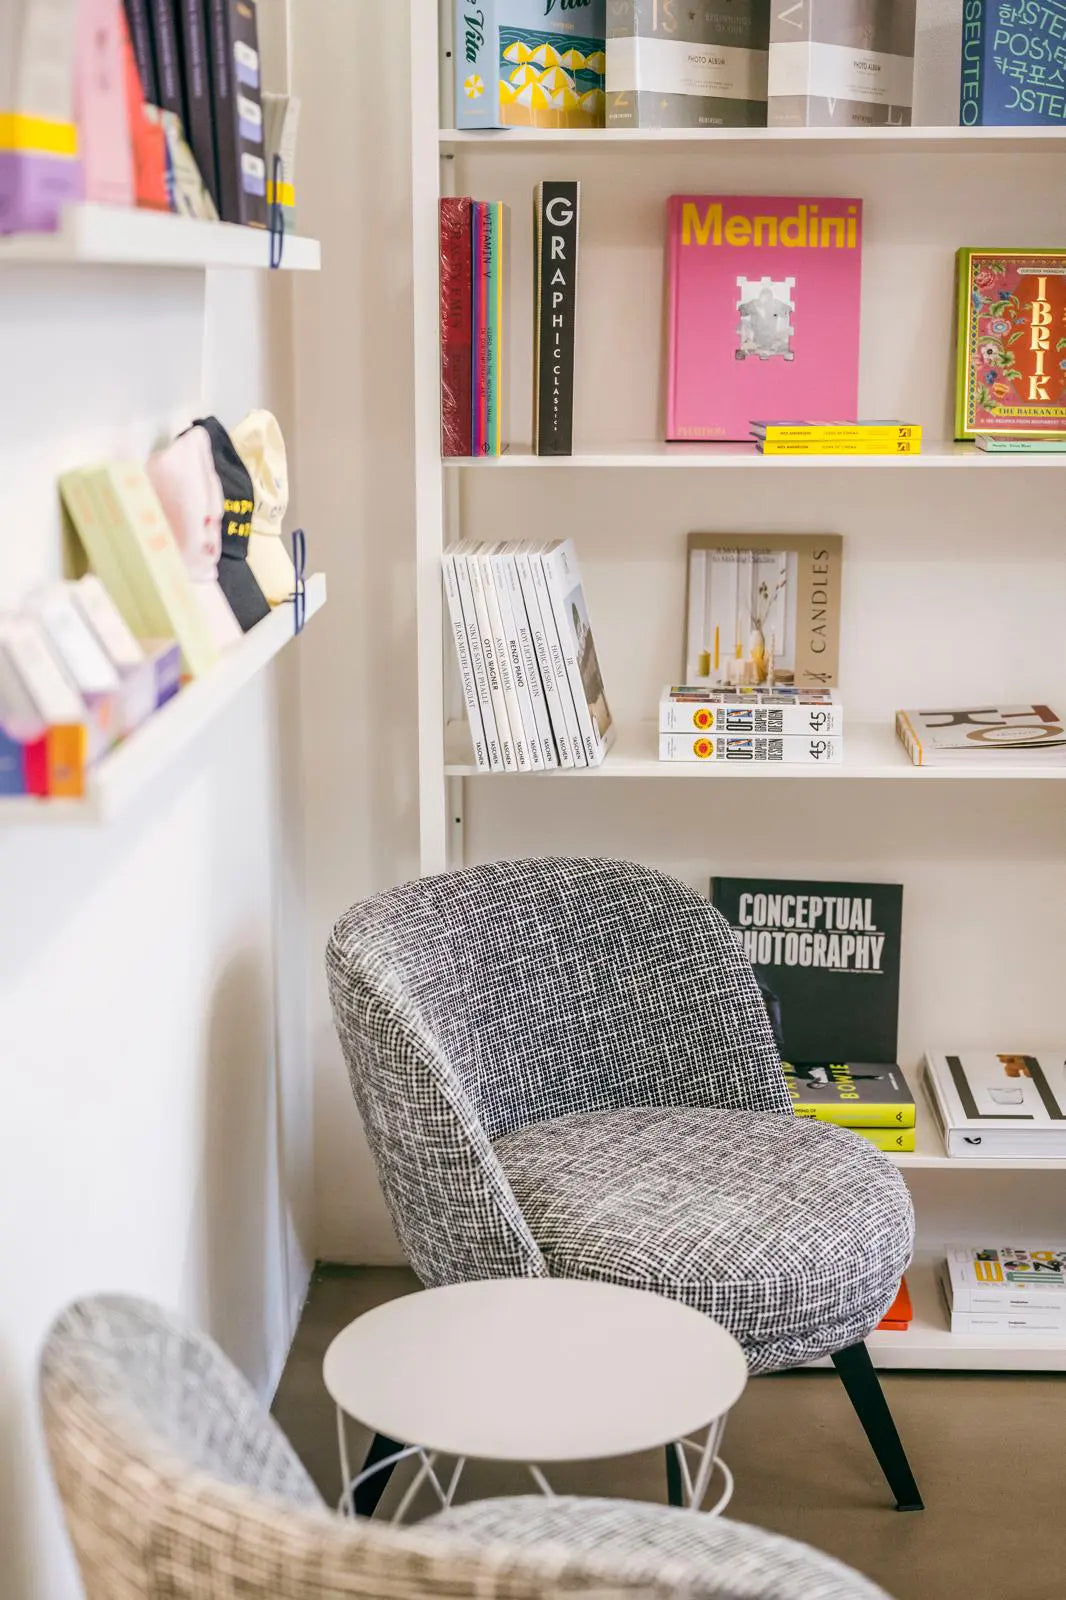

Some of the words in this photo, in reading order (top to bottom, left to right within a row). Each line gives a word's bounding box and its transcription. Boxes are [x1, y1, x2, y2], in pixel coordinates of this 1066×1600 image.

[464, 10, 485, 64] Vita
[688, 56, 706, 64] PHOTO
[708, 56, 726, 65] ALBUM
[854, 60, 868, 70] PHOTO
[681, 202, 857, 248] Mendini
[482, 212, 492, 264] VITAMIN
[482, 270, 492, 279] V
[544, 197, 574, 358] GRAPHIC
[1028, 277, 1053, 401] IBRIK
[811, 549, 828, 654] CANDLES
[468, 623, 476, 640] NIKI
[519, 628, 528, 643] ROY
[471, 641, 478, 650] DE
[483, 638, 492, 658] OTTO
[473, 651, 483, 674] SAINT
[523, 644, 539, 697] LICHTENSTEIN
[487, 660, 498, 690] WAGNER
[453, 621, 468, 671] JEAN-MICHEL
[463, 672, 475, 708] BASQUIAT
[475, 741, 484, 765] TASCHEN
[478, 676, 488, 705] PHALLE
[495, 636, 504, 658] ANDY
[500, 659, 512, 692] WARHOL
[516, 741, 525, 764] TASCHEN
[509, 640, 519, 663] RENZO
[514, 665, 524, 687] PIANO
[530, 739, 538, 762] TASCHEN
[534, 630, 547, 664] GRAPHIC
[542, 665, 553, 692] DESIGN
[559, 736, 567, 760] TASCHEN
[550, 644, 563, 678] HOKUSAI
[572, 736, 580, 759] TASCHEN
[726, 718, 753, 732] OF
[755, 710, 766, 732] GRAPHIC
[768, 710, 782, 732] DESIGN
[808, 712, 826, 732] 45
[490, 740, 498, 763] TASCHEN
[503, 741, 511, 764] TASCHEN
[543, 738, 552, 761] TASCHEN
[585, 736, 594, 759] TASCHEN
[726, 746, 753, 760] OF
[755, 738, 766, 760] GRAPHIC
[768, 738, 782, 760] DESIGN
[808, 740, 826, 760] 45
[738, 892, 876, 932] CONCEPTUAL
[830, 1064, 860, 1099] BOWIE
